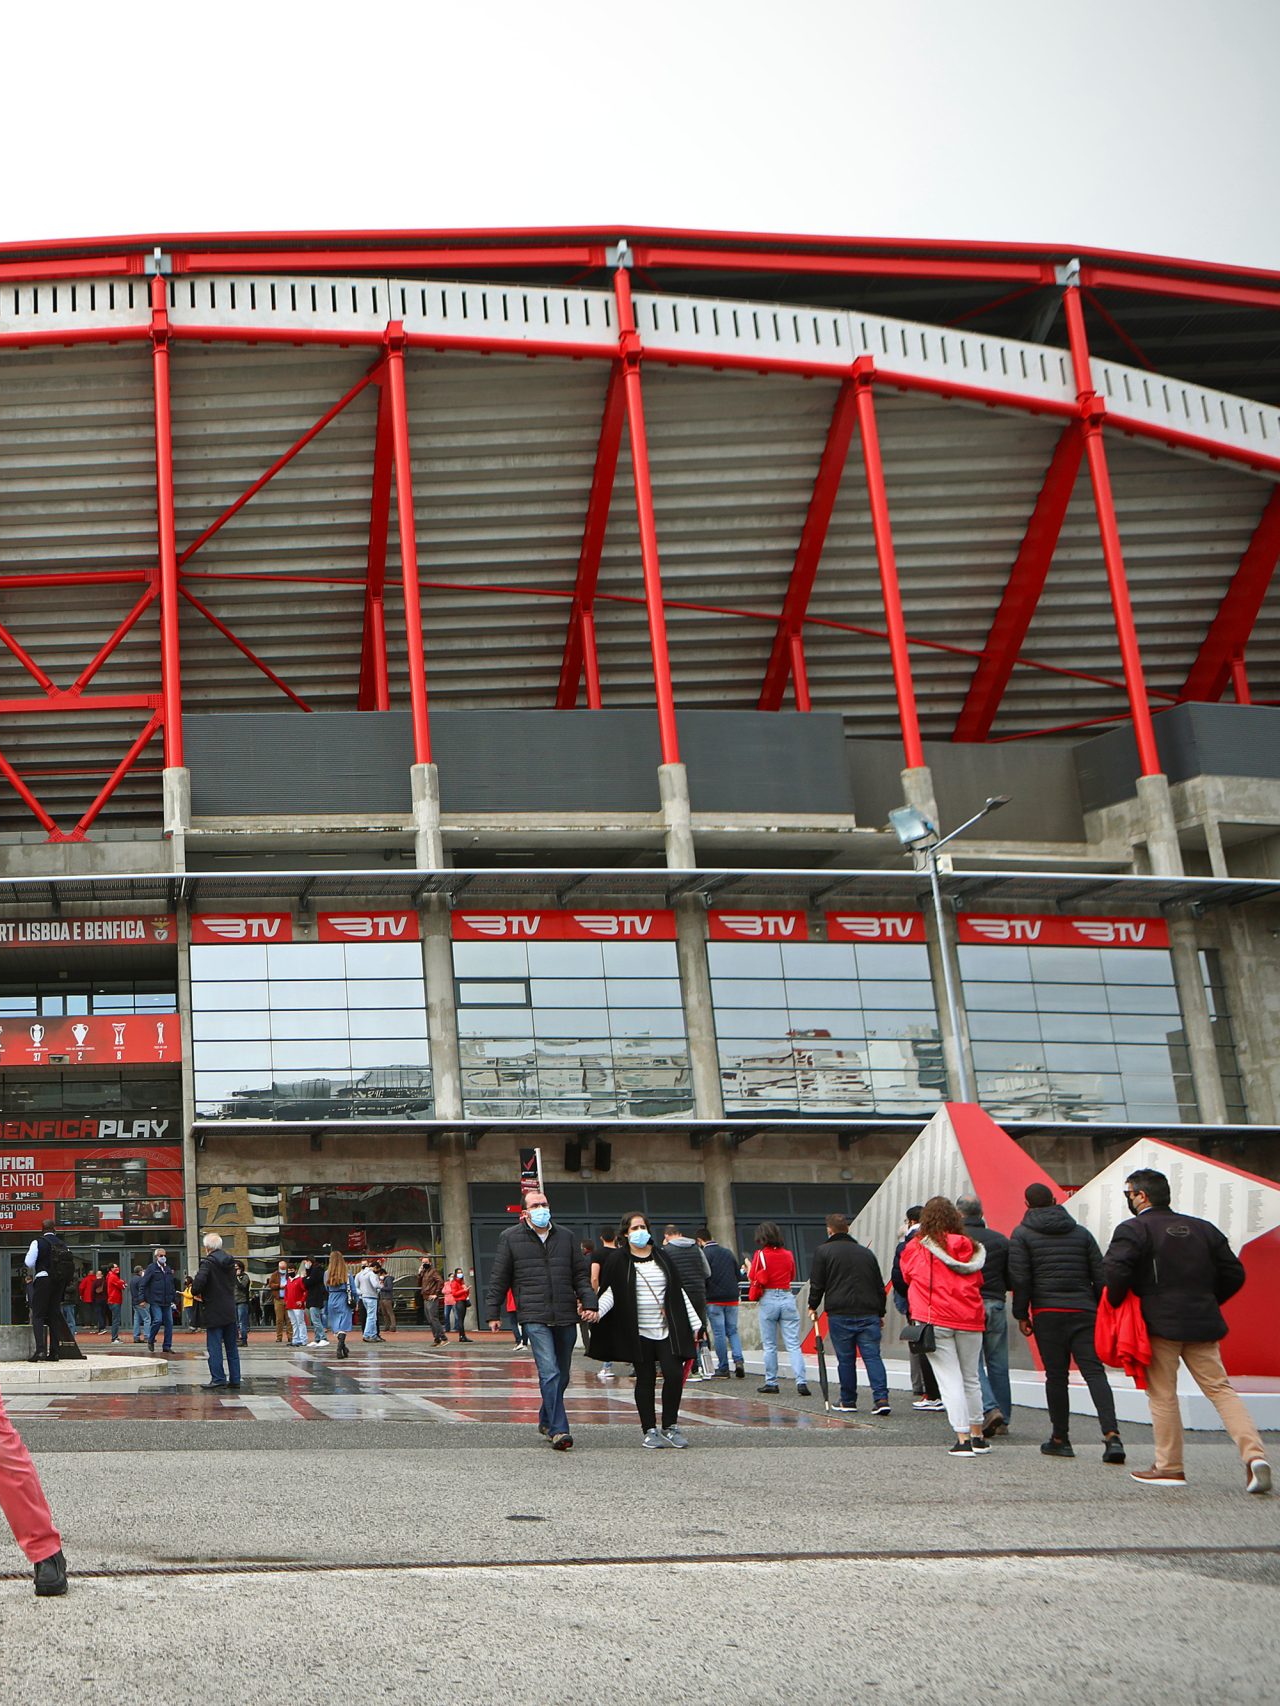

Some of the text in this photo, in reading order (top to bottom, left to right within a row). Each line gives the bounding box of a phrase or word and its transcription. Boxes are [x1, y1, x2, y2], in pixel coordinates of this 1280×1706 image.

[19, 921, 70, 941] LISBOA
[73, 921, 81, 940] E
[85, 920, 145, 940] BENFICA
[201, 918, 281, 938] BTV
[328, 917, 407, 937] BTV
[461, 915, 540, 935] BTV
[573, 915, 652, 935] BTV
[718, 915, 796, 936] BTV
[836, 917, 913, 937] BTV
[967, 919, 1041, 940] BTV
[1072, 921, 1146, 943] BTV
[34, 1053, 40, 1061] 37
[78, 1052, 82, 1060] 2
[117, 1051, 121, 1060] 8
[158, 1050, 162, 1059] 7
